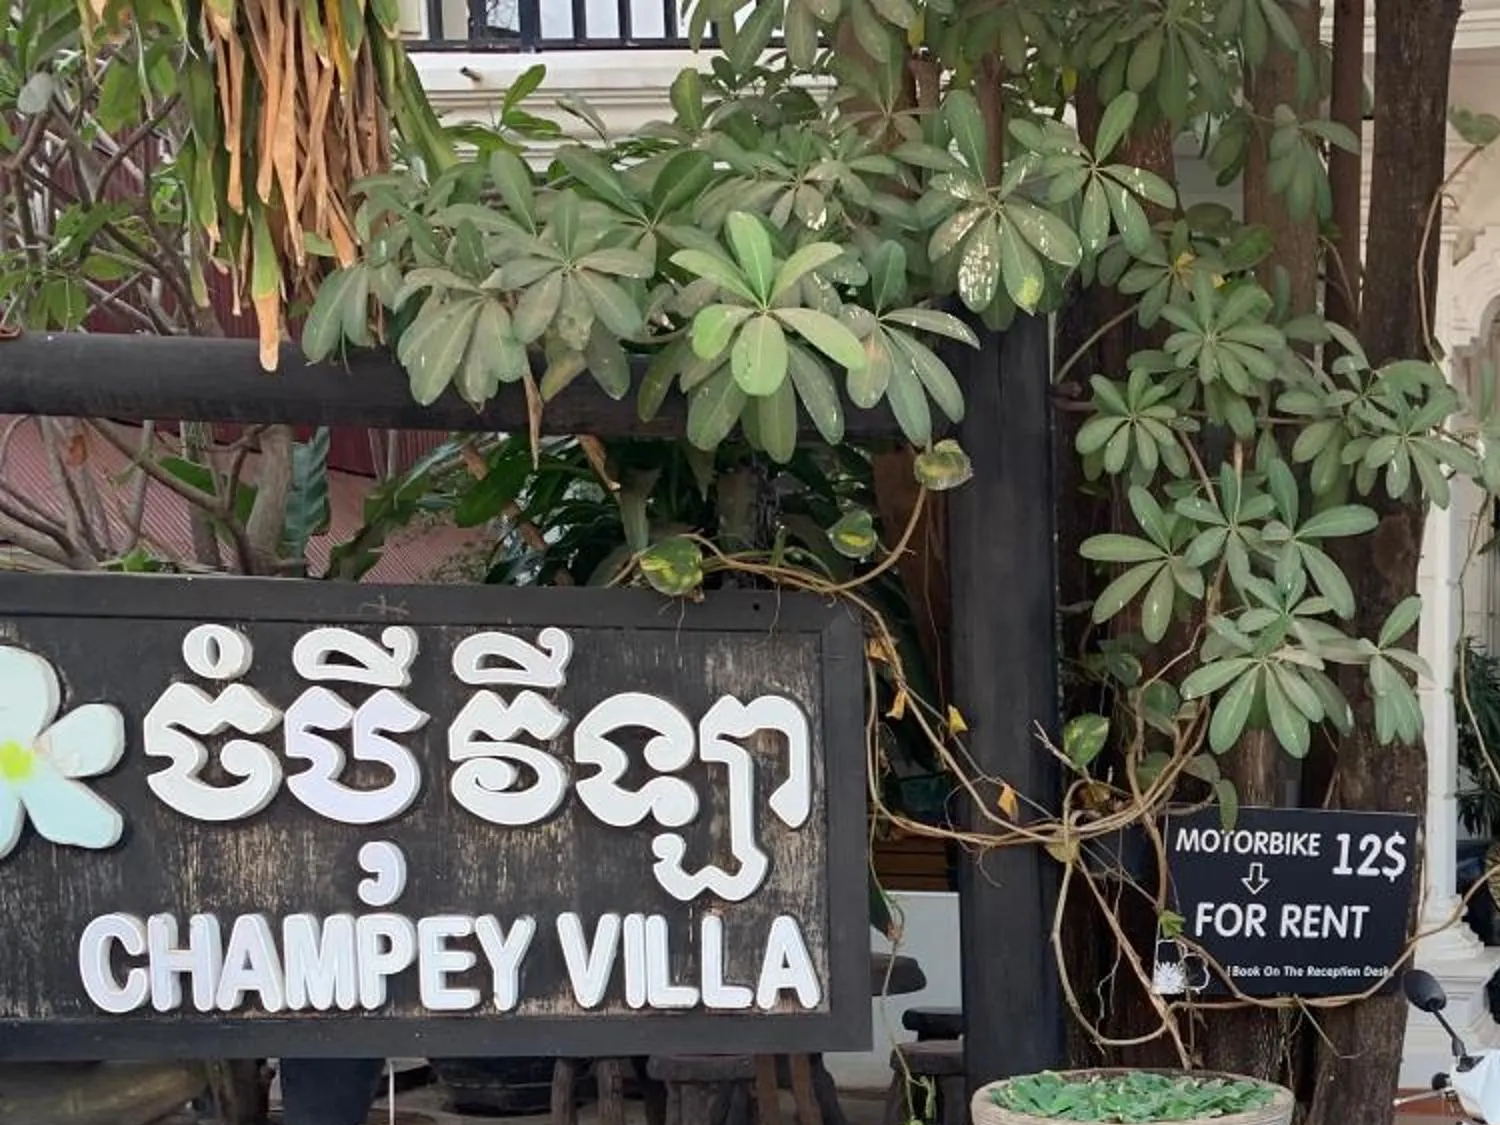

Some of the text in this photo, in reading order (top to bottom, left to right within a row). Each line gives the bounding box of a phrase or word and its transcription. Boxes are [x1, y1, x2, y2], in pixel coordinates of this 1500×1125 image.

[1175, 828, 1407, 882] MOTORBIKE 12$
[1194, 902, 1371, 939] FOR RENT
[78, 911, 822, 1014] CHAMPEY VILLA
[1263, 965, 1281, 977] On
[1284, 965, 1304, 977] The
[1307, 965, 1361, 979] Reception
